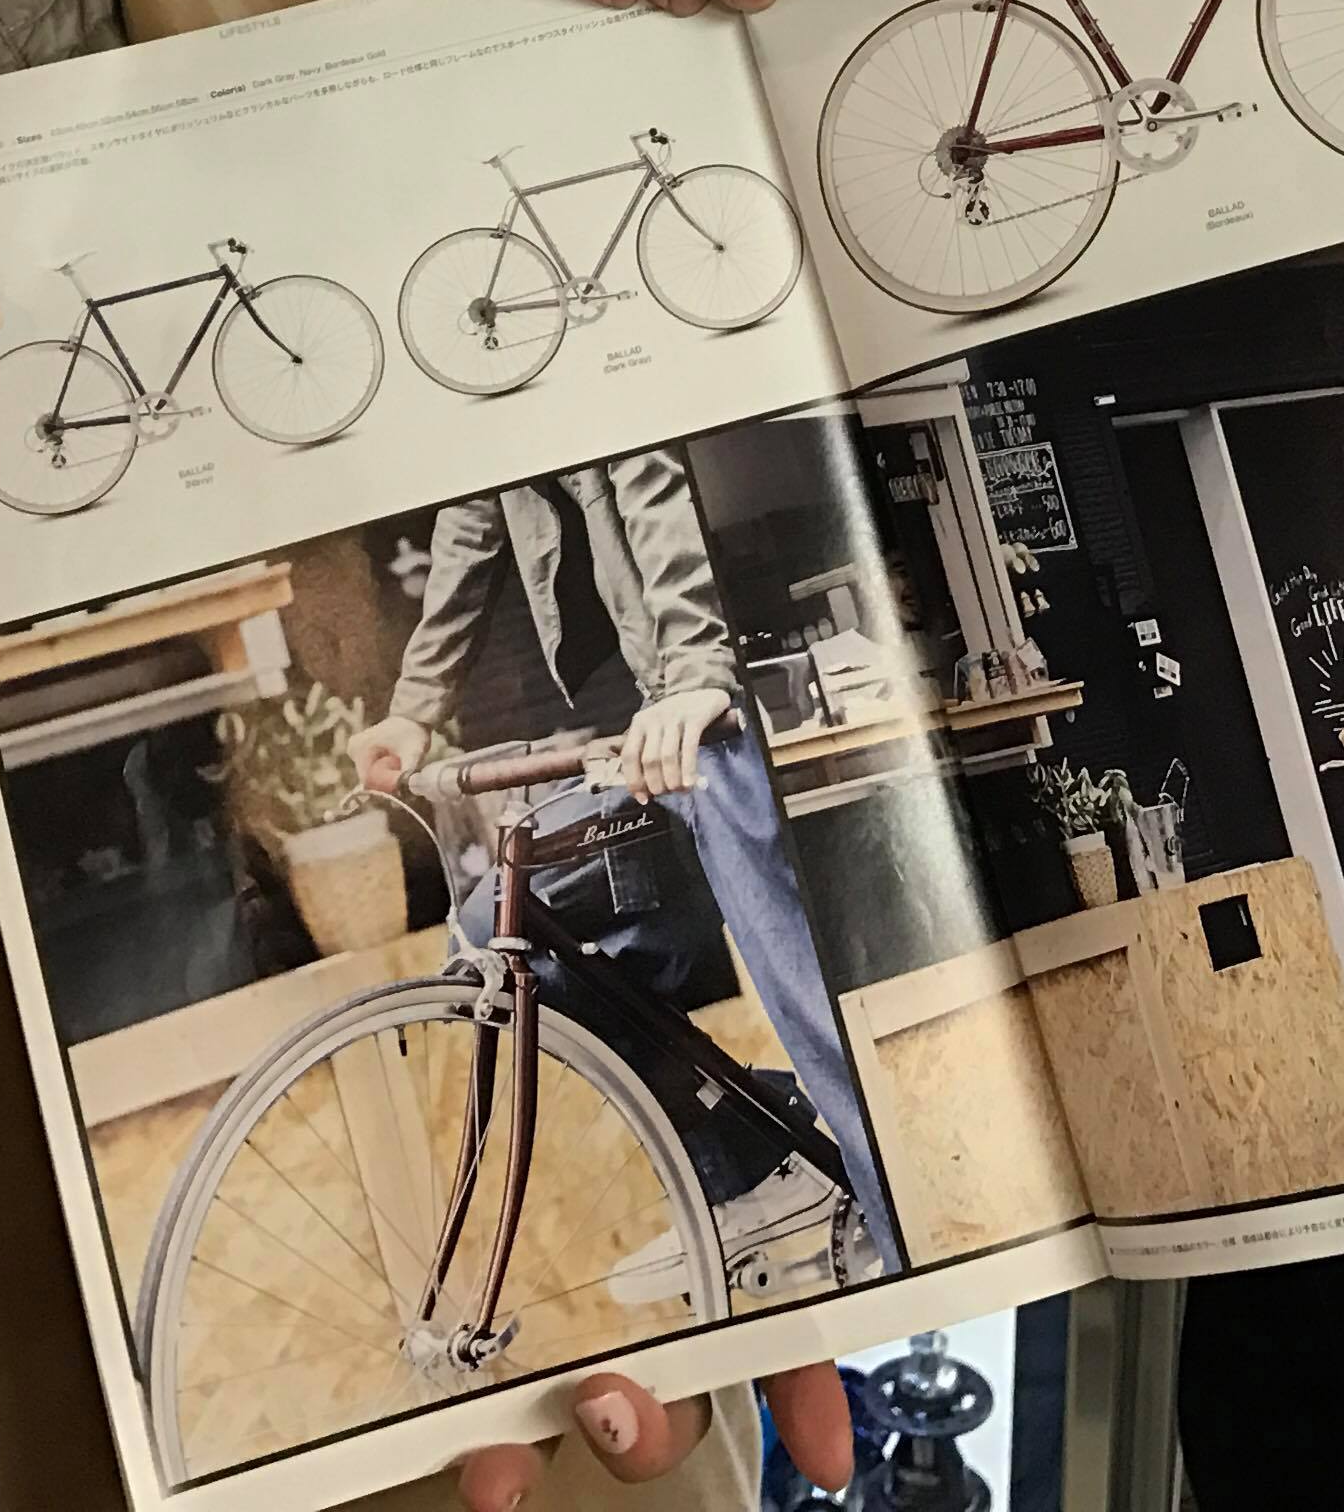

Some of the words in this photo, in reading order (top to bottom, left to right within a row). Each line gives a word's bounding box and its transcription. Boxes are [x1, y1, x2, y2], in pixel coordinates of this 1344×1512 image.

[219, 15, 281, 40] LIFESTYLE
[16, 132, 43, 145] Sizes
[210, 84, 247, 100] Color(s)
[1208, 201, 1245, 218] BALLAD
[606, 345, 642, 361] BALLAD
[576, 812, 654, 847] Ballad
